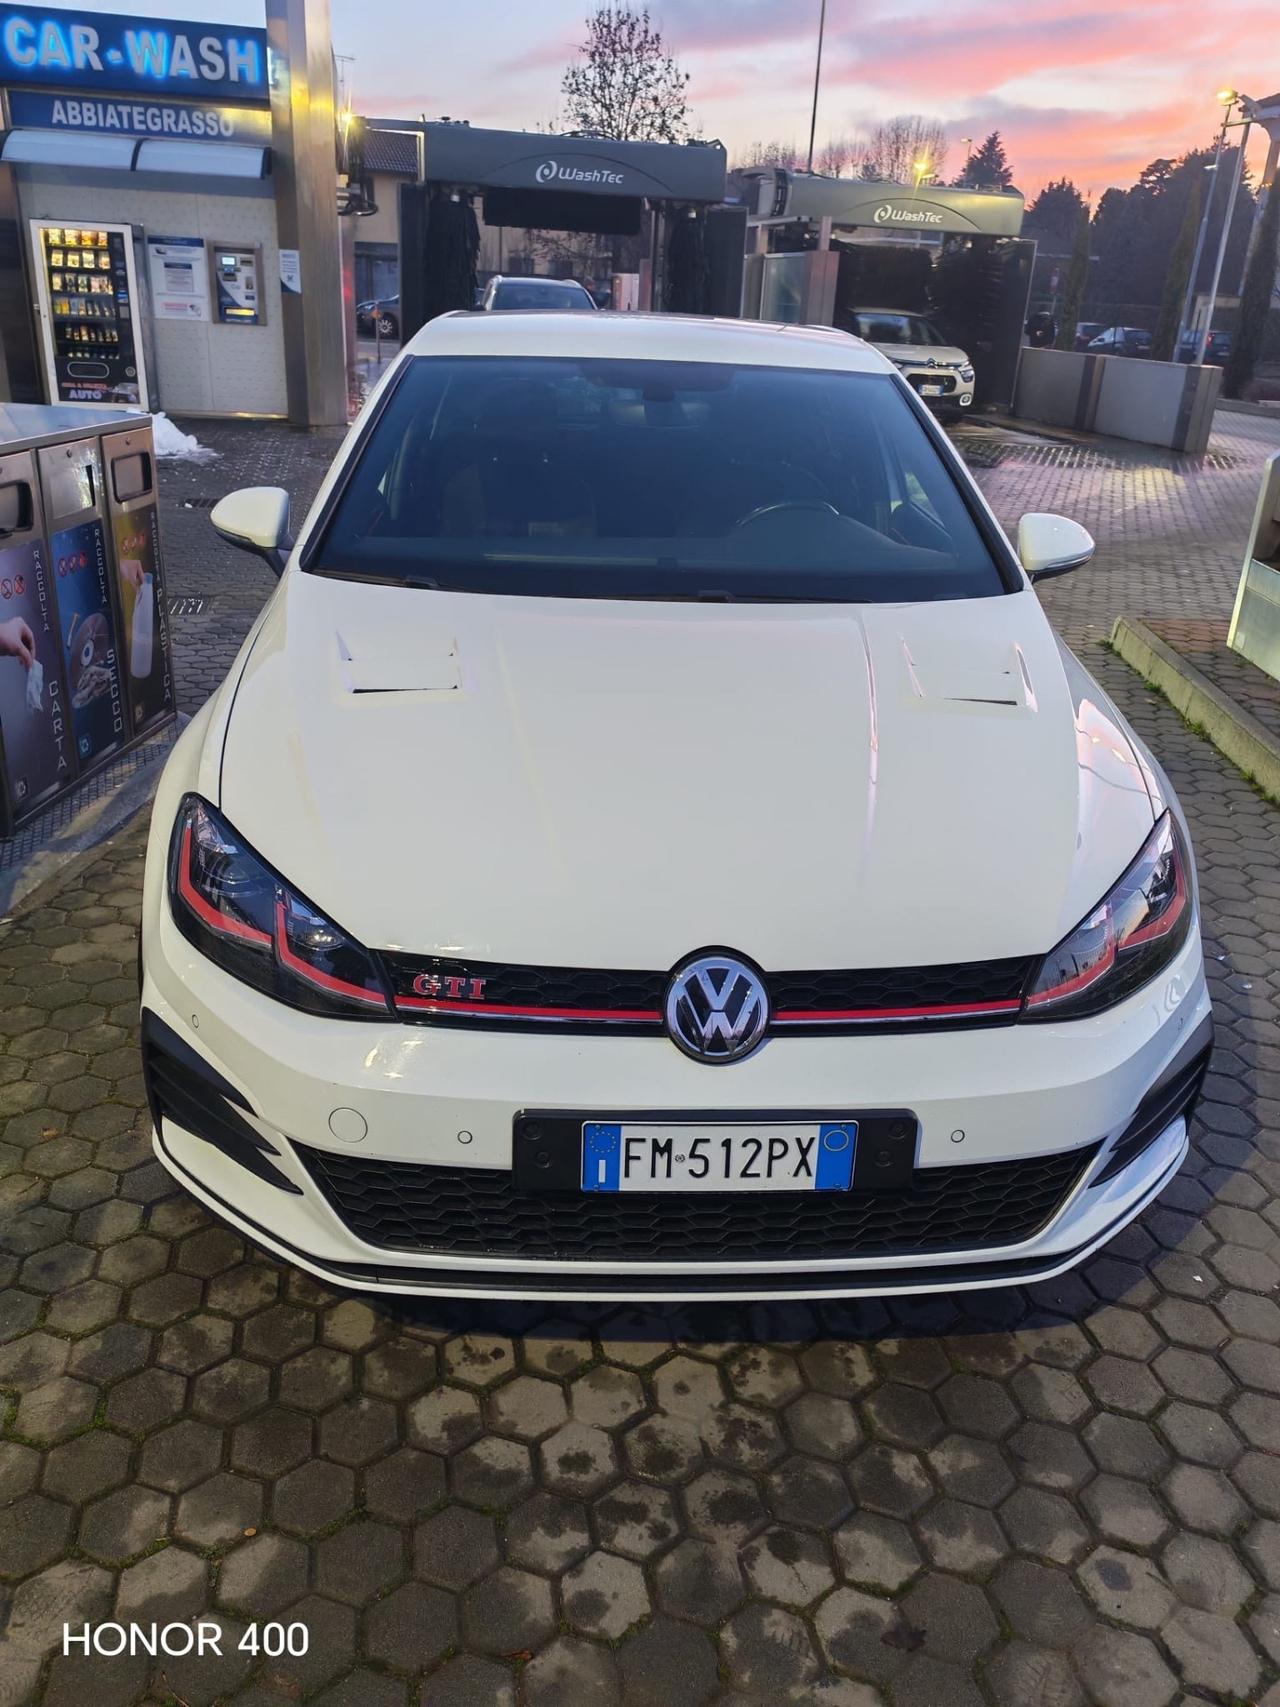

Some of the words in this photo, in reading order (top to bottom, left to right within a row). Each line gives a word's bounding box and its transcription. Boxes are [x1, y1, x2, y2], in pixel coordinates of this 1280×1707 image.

[52, 100, 234, 137] ABBIATEGRASSO
[558, 167, 624, 184] WashTec
[891, 210, 943, 223] WashTec
[69, 389, 102, 399] AUTO
[94, 528, 107, 604] RACCOLTA
[106, 649, 123, 732] SECCO
[156, 588, 171, 701] PLASTICA
[33, 550, 50, 632] RACCOLTA
[49, 680, 68, 771] CARTA
[412, 973, 487, 1000] GTI
